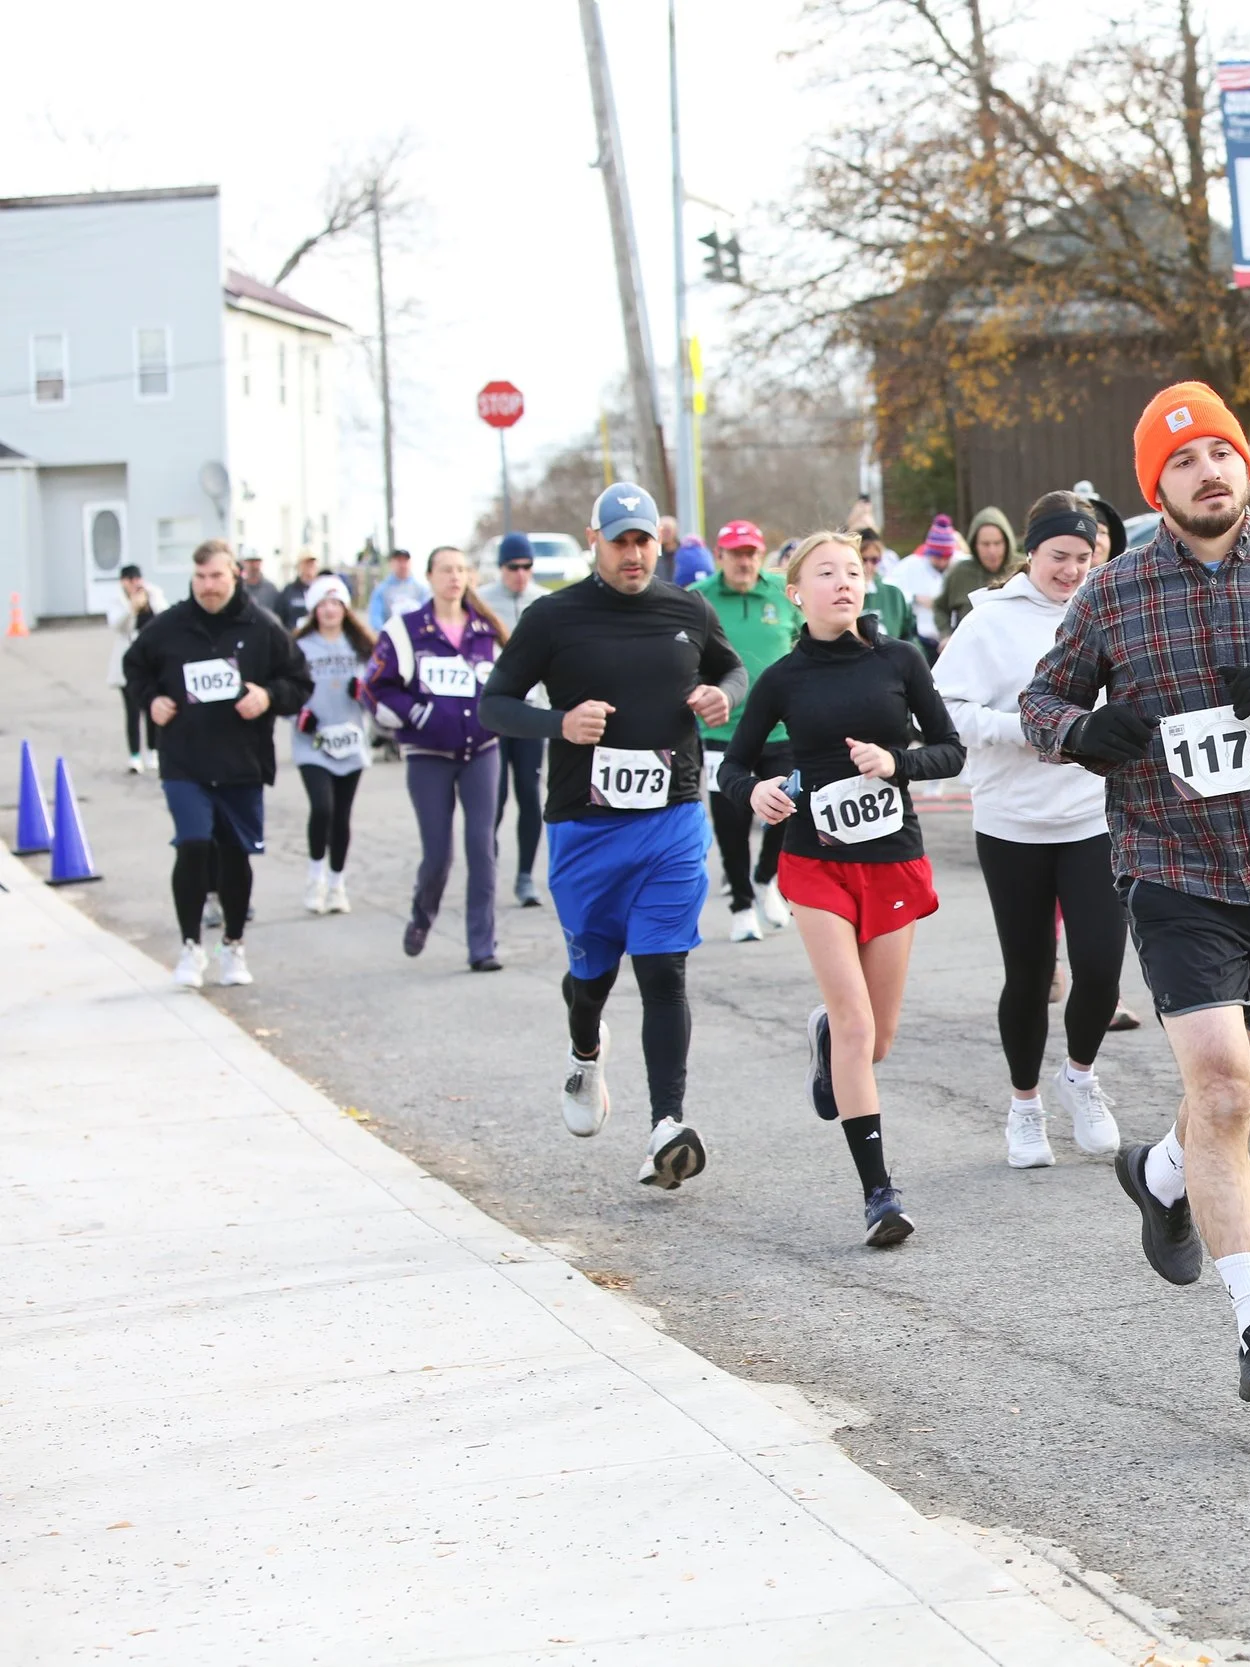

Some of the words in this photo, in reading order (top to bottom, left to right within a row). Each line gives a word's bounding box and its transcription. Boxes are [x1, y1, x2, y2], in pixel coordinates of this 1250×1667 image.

[478, 392, 523, 416] STOP
[192, 672, 234, 691] 1052
[427, 668, 470, 685] 1172
[599, 766, 665, 793] 1073
[820, 787, 898, 832] 1082
